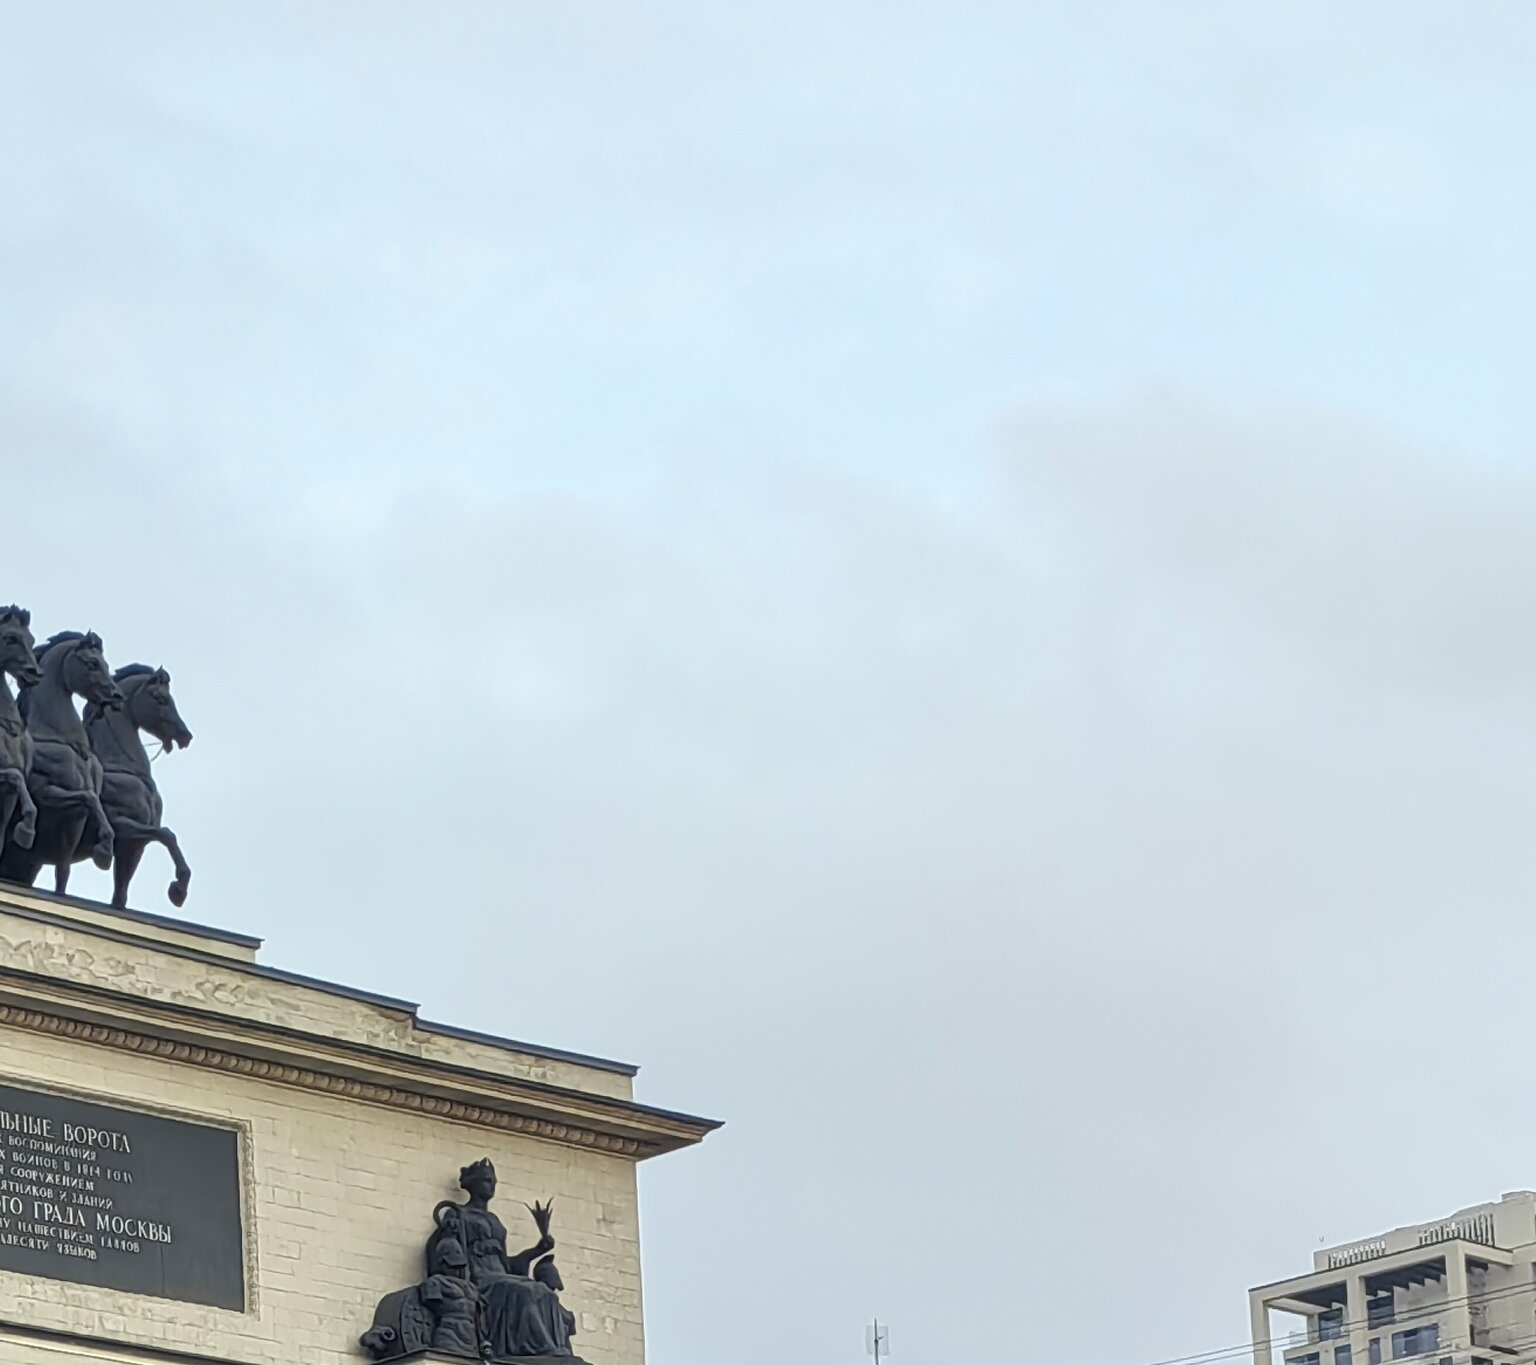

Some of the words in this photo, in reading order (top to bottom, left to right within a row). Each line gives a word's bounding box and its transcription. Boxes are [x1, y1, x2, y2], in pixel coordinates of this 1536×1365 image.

[63, 1123, 131, 1153] ВОРОТА
[33, 1201, 86, 1227] ГРАДА
[96, 1212, 172, 1243] МОСКВЫ
